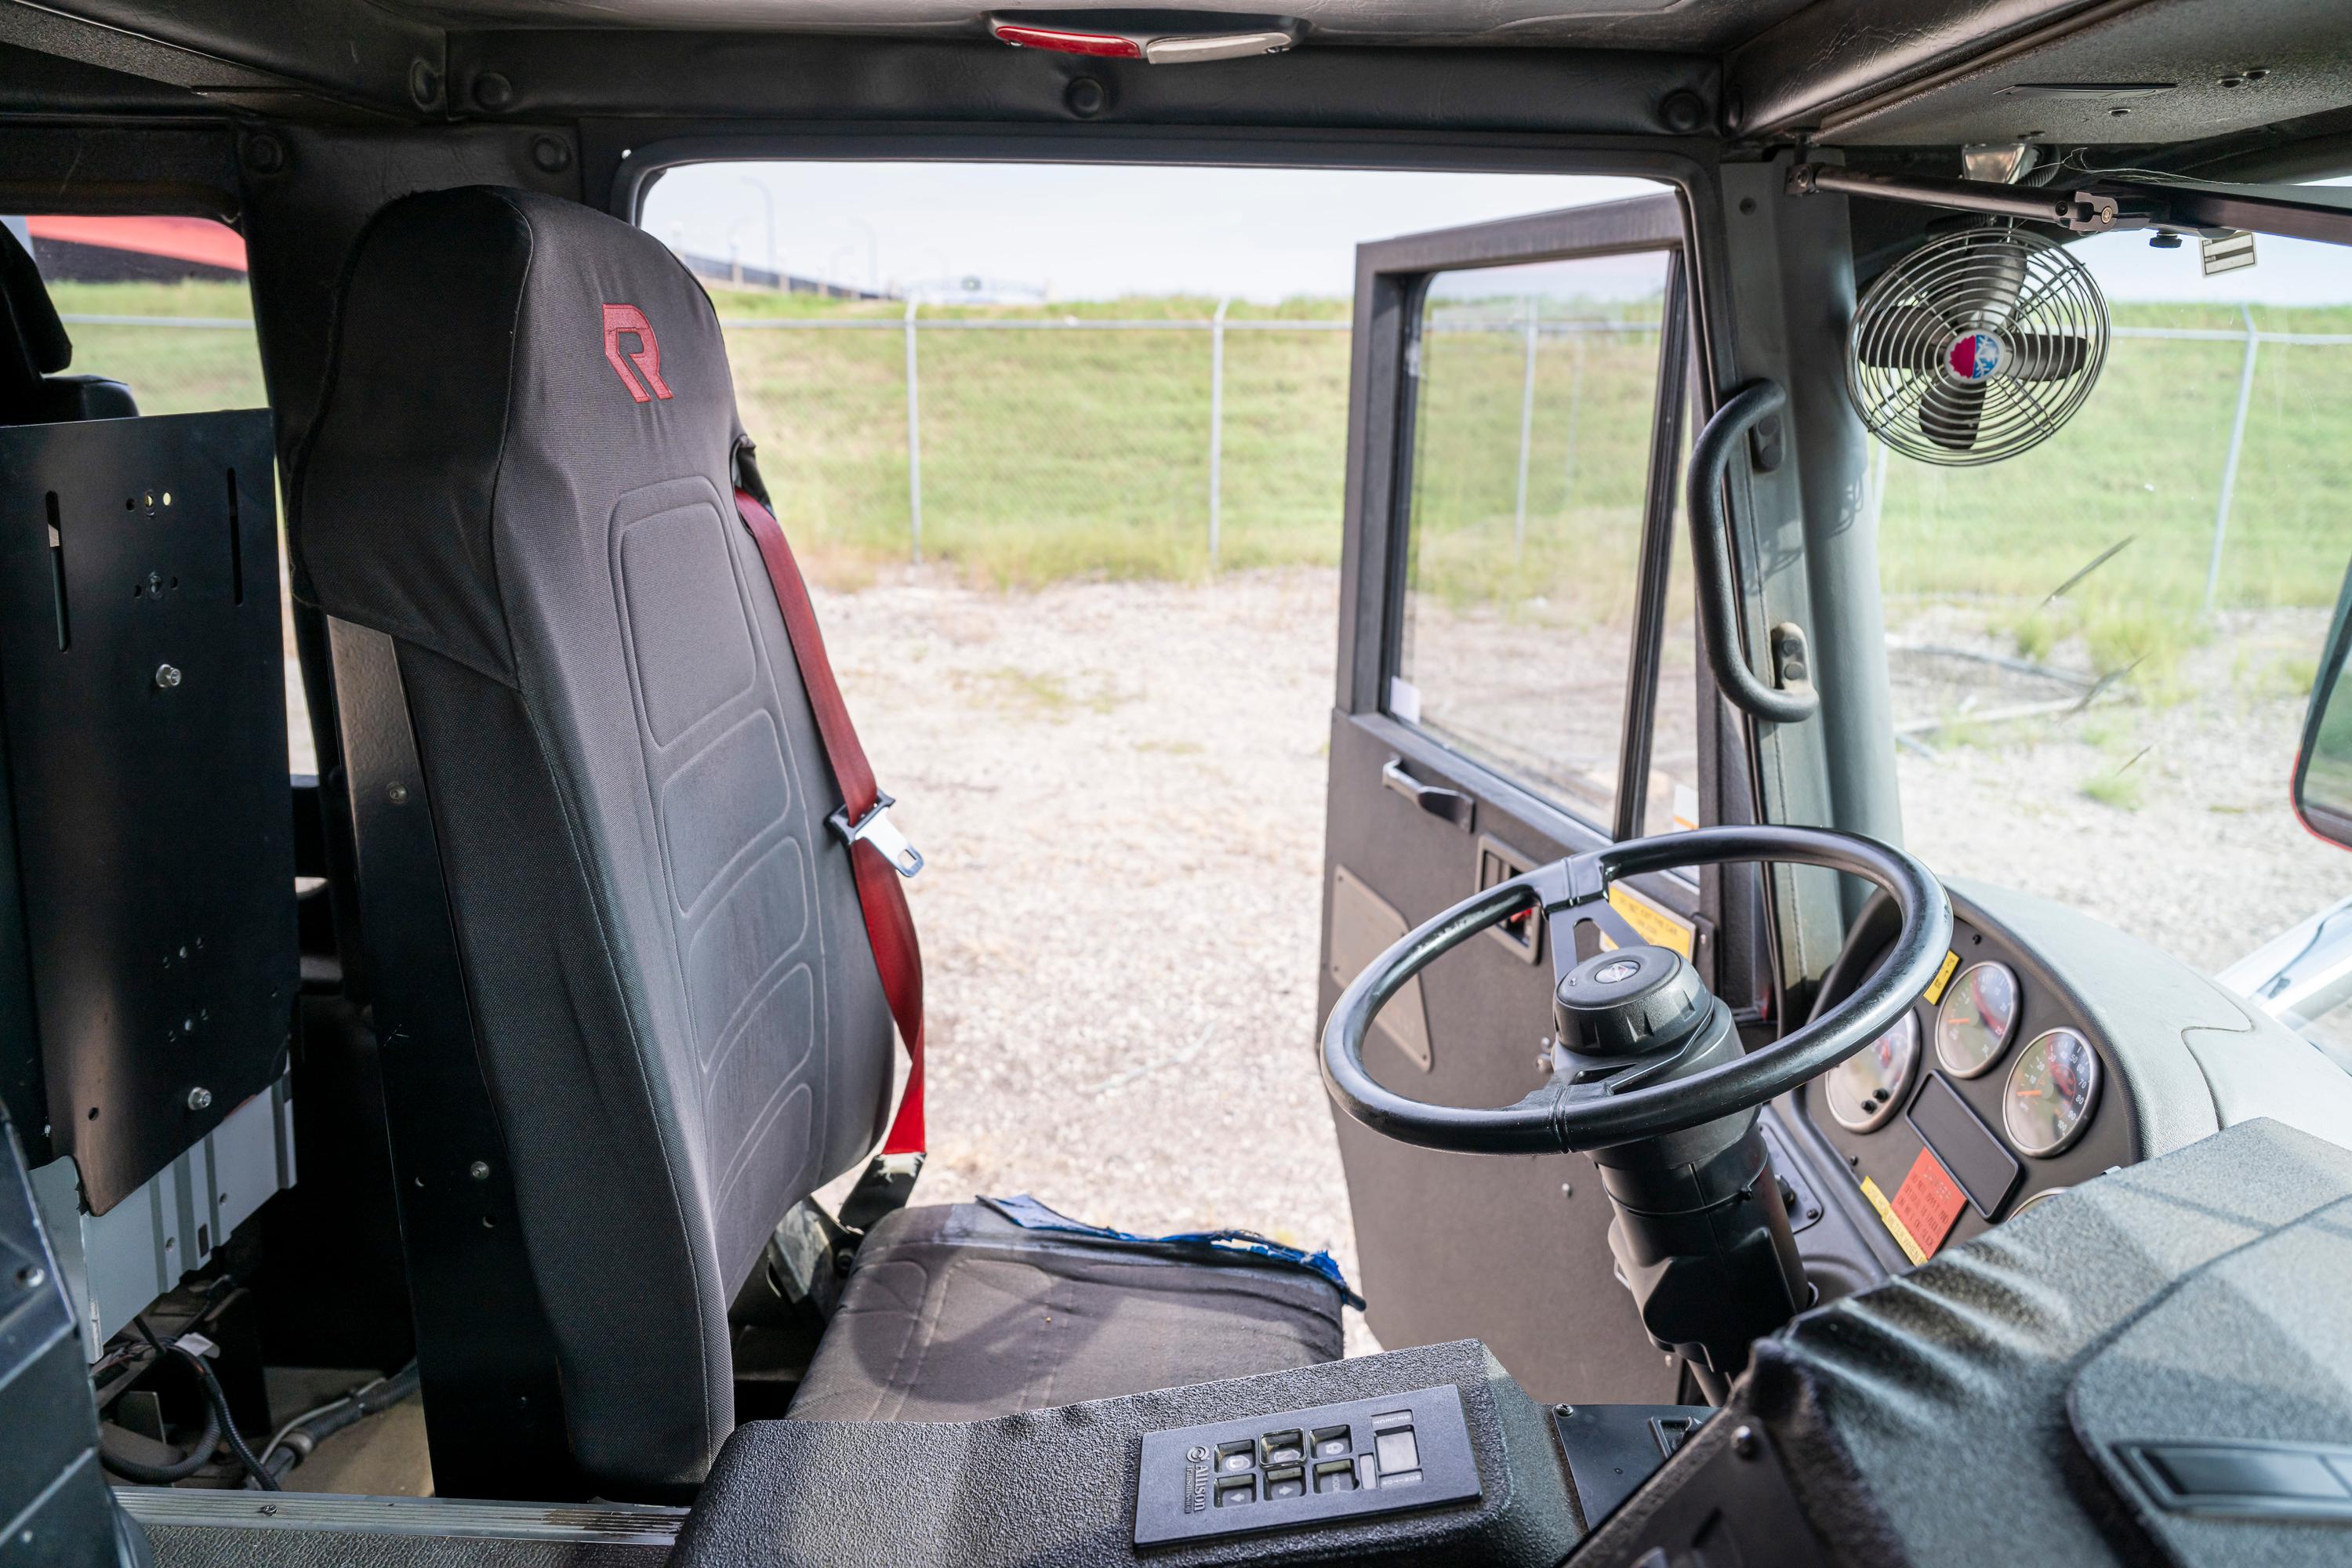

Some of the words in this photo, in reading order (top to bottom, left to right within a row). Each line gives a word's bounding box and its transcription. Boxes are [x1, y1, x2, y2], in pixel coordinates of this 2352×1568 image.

[1994, 1025, 2004, 1036] 25
[2048, 1054, 2057, 1062] 30
[2070, 1054, 2078, 1064] 50
[2036, 1062, 2045, 1072] 20
[2076, 1063, 2085, 1074] 60
[2029, 1074, 2037, 1085] 10
[2078, 1079, 2087, 1089] 70
[2075, 1095, 2084, 1105] 80
[2067, 1110, 2077, 1121] 90
[2056, 1120, 2067, 1131] 100
[1185, 1465, 1193, 1514] Transmission
[1194, 1465, 1208, 1512] Allison
